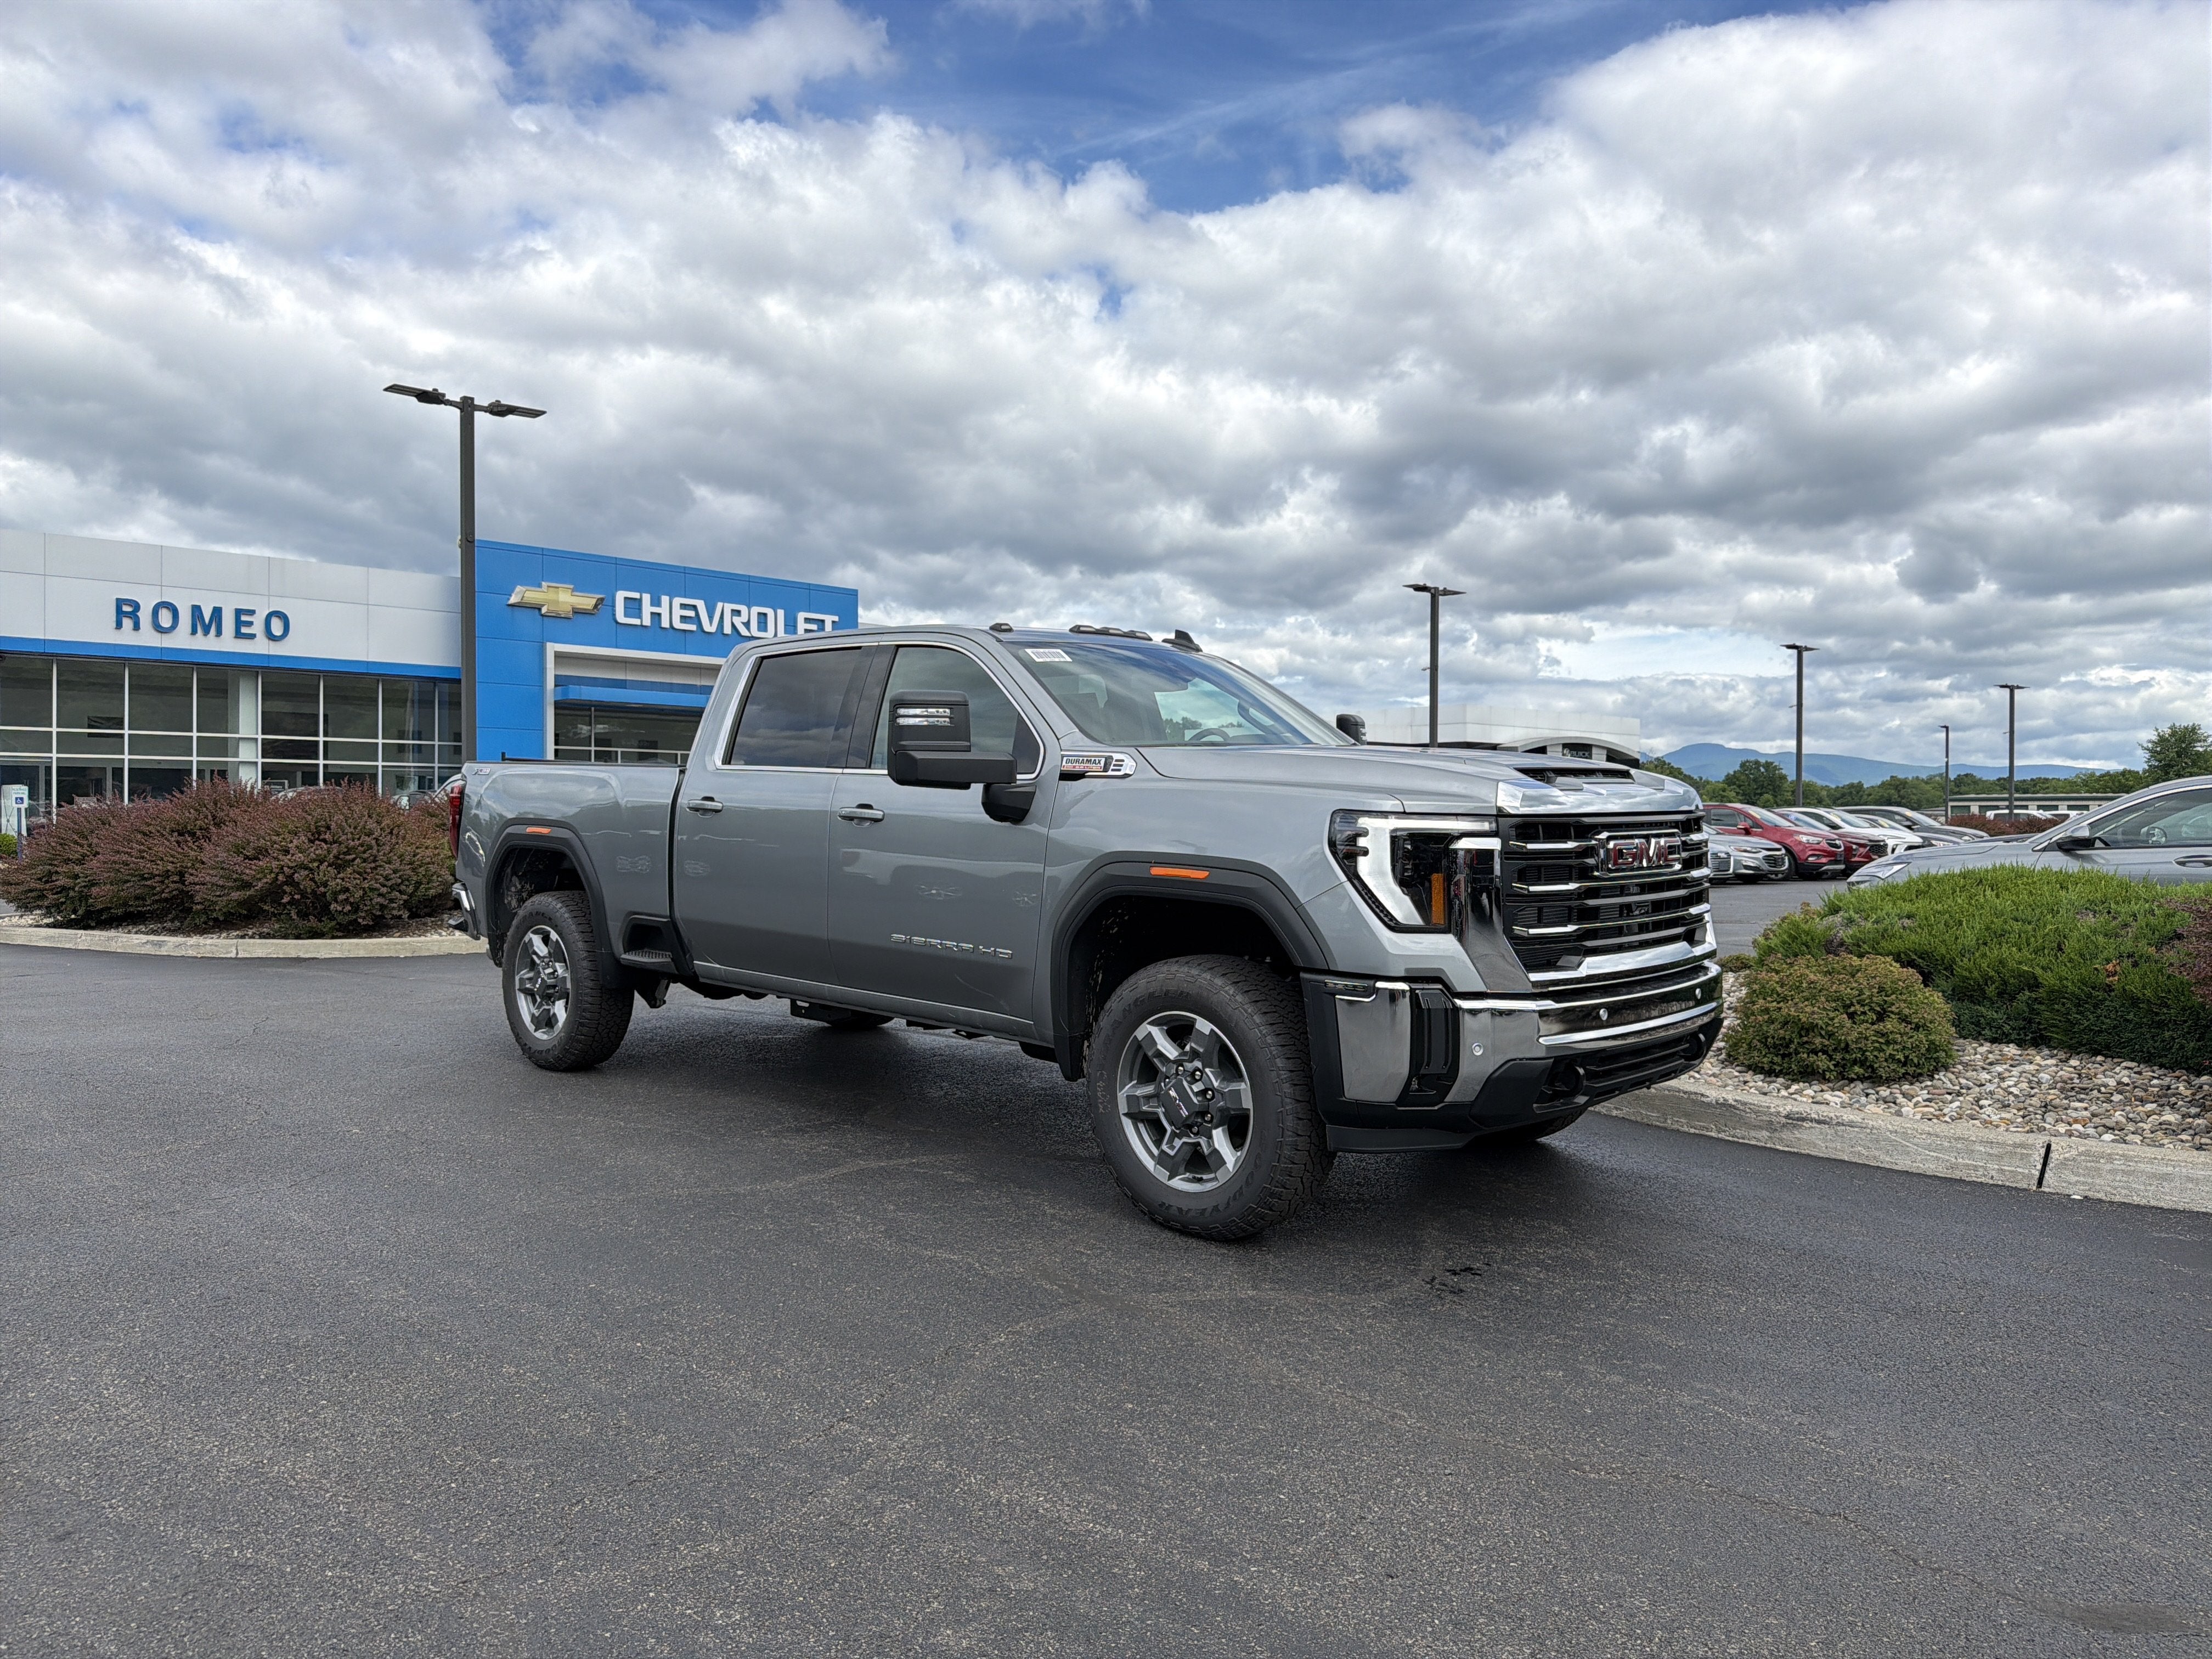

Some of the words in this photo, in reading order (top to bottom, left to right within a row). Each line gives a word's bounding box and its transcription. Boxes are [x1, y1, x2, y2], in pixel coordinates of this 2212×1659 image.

[114, 597, 290, 641] ROMEO
[615, 590, 839, 638] CHEVROLET
[1608, 837, 1681, 869] GMC
